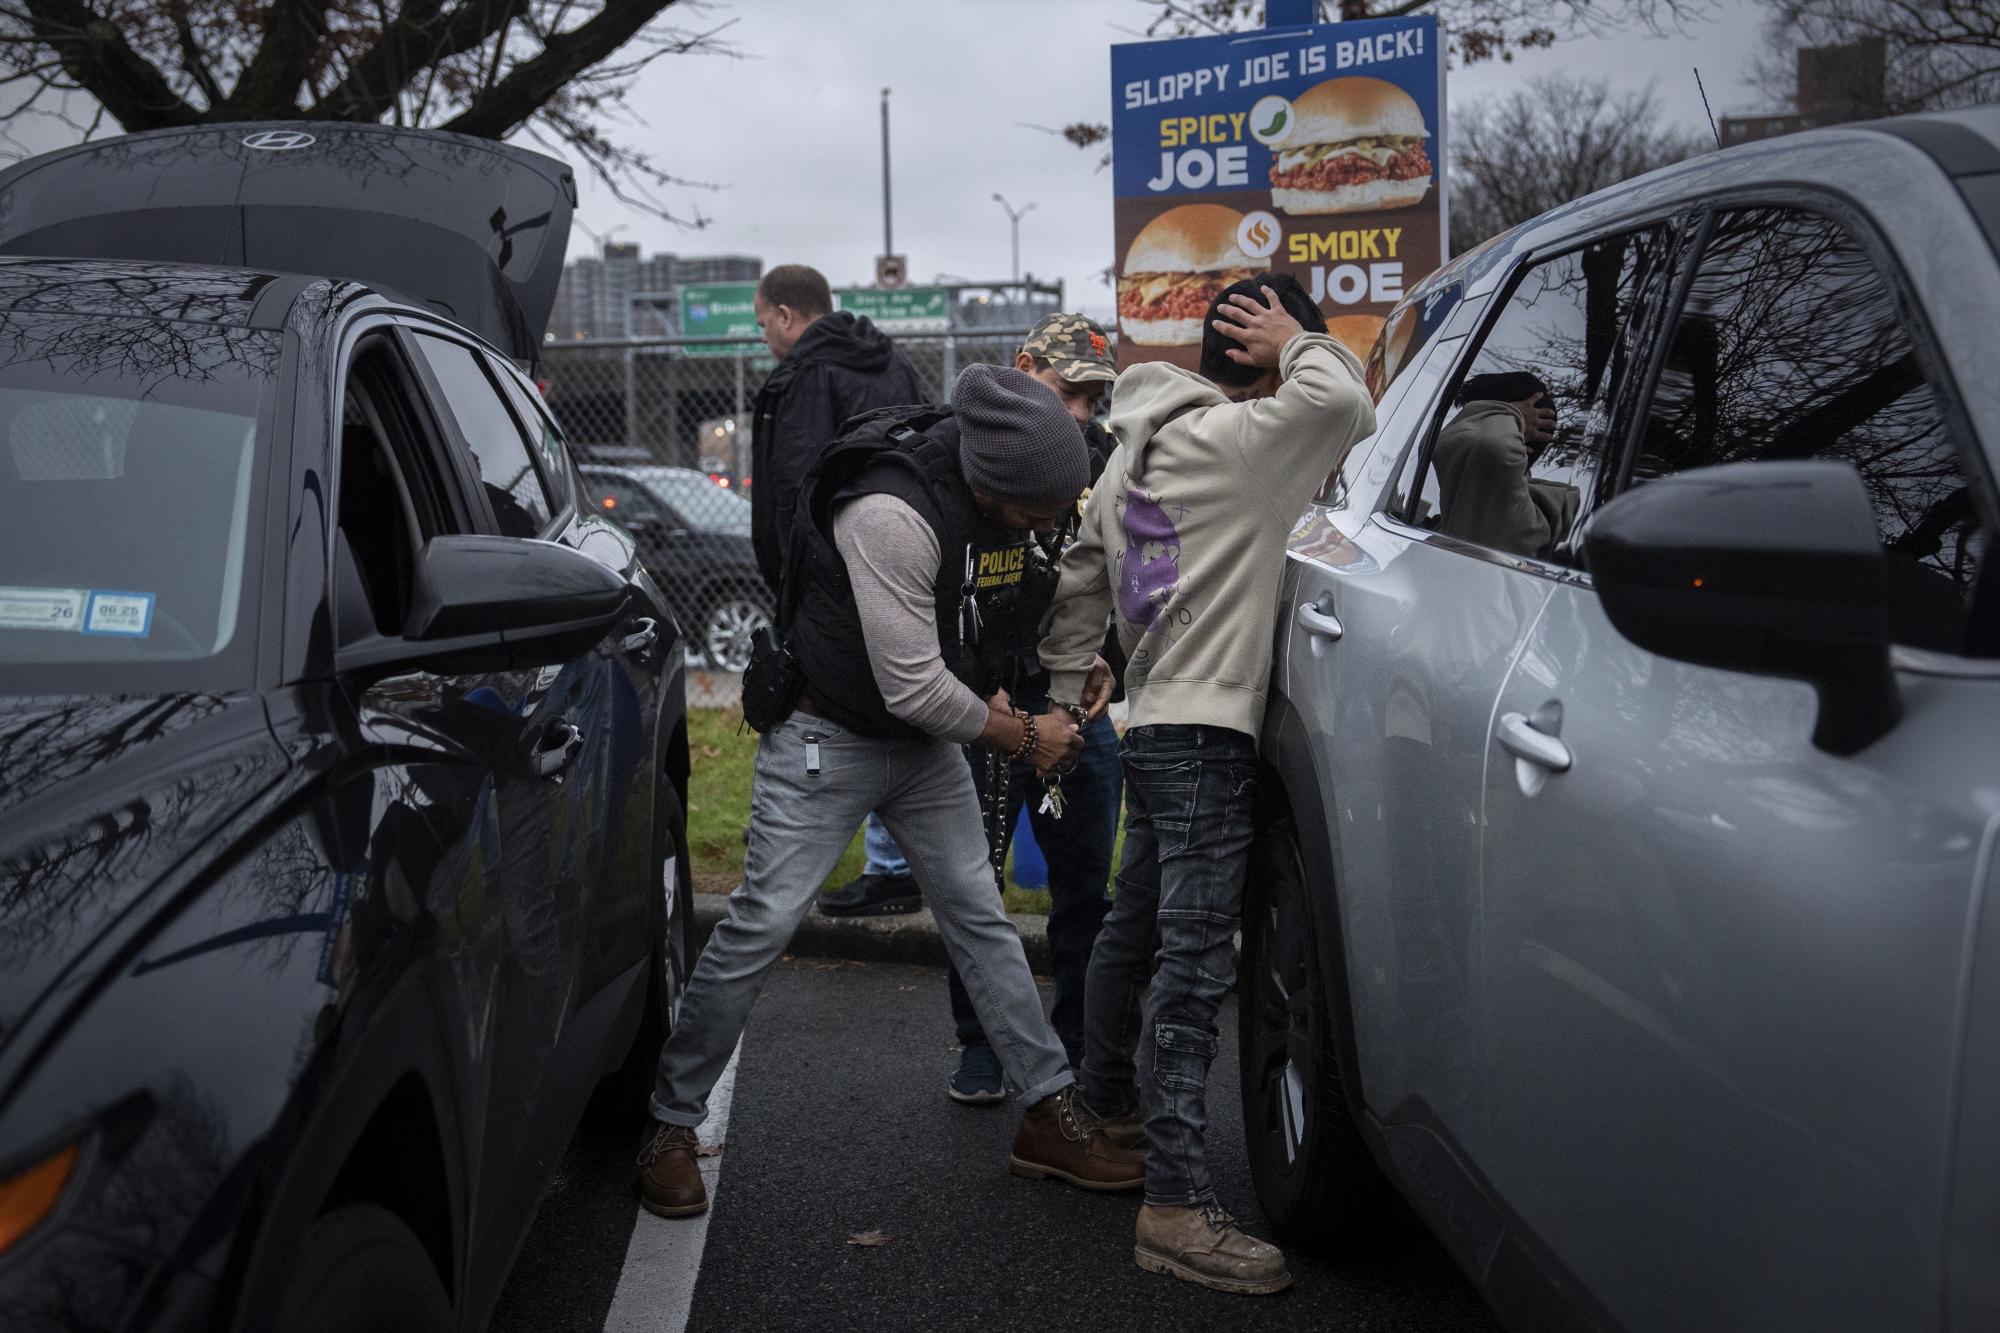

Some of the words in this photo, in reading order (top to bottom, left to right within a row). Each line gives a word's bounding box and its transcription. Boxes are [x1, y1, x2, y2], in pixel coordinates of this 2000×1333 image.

[1125, 65, 1229, 109] SLOPPY
[1239, 52, 1290, 88] JOE
[1299, 45, 1327, 75] IS
[1336, 28, 1424, 70] BACK!
[1160, 112, 1247, 147] SPICY
[1147, 146, 1249, 192] JOE
[1288, 227, 1403, 264] SMOKY
[1308, 262, 1405, 306] JOE
[977, 576, 1002, 587] FEDERAL
[1003, 571, 1022, 583] AGENT
[979, 548, 1024, 574] POLICE
[51, 607, 73, 617] 26
